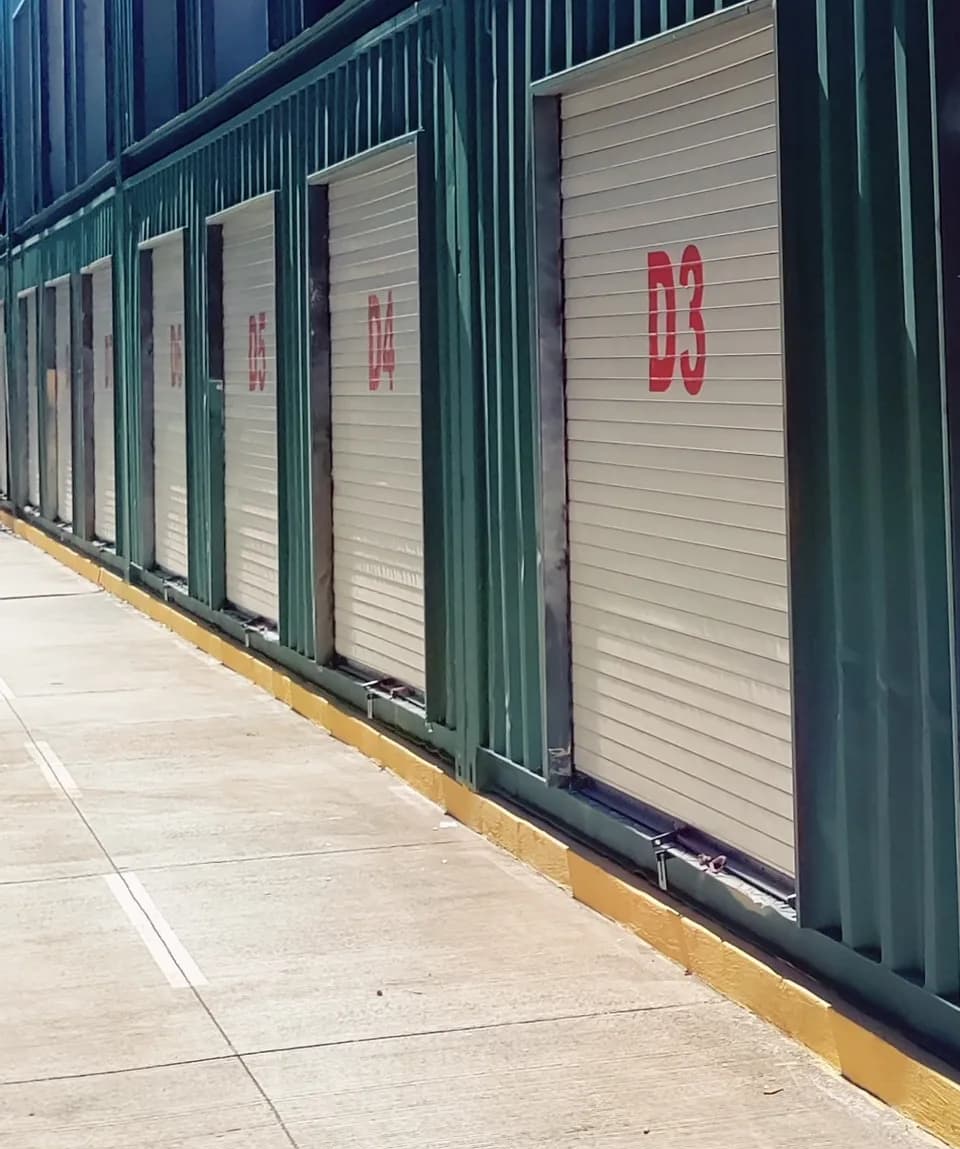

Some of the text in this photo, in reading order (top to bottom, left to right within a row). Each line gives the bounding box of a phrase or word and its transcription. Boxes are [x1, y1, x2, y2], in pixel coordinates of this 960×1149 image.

[249, 312, 266, 391] D5
[368, 291, 396, 391] D4
[648, 245, 707, 396] D3
